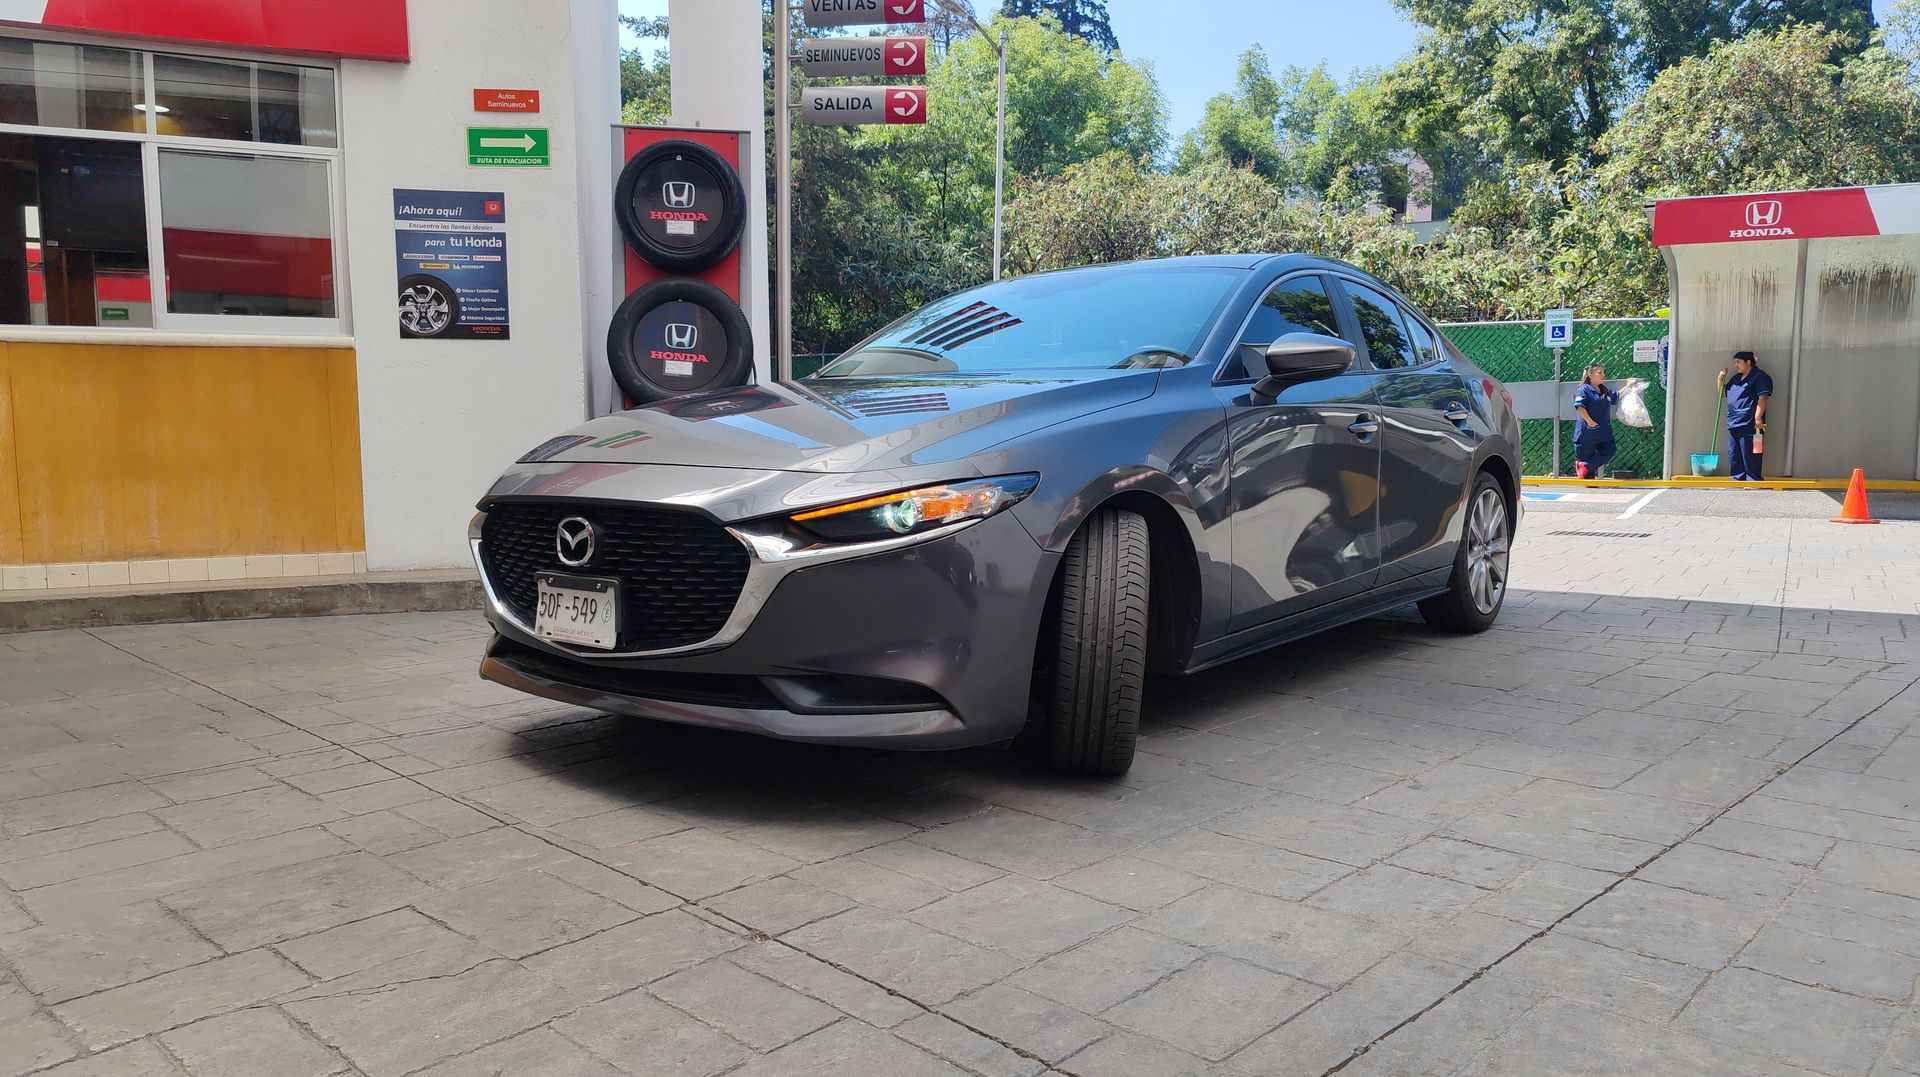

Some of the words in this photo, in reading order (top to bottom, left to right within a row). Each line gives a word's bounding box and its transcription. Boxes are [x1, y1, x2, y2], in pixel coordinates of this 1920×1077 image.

[811, 0, 877, 12] VENTAS
[806, 47, 881, 63] SEMINUEVOS
[487, 100, 527, 108] Seminuevos
[813, 97, 873, 111] SALIDA
[398, 205, 434, 215] ¡Ahora
[436, 207, 463, 218] aquí!
[649, 211, 709, 221] HONDA
[408, 222, 440, 230] Encuentra
[1728, 227, 1795, 238] HONDA
[424, 239, 446, 248] para
[449, 236, 463, 247] tu
[465, 236, 503, 248] Honda
[650, 351, 709, 363] HONDA
[539, 592, 598, 625] 50F-549
